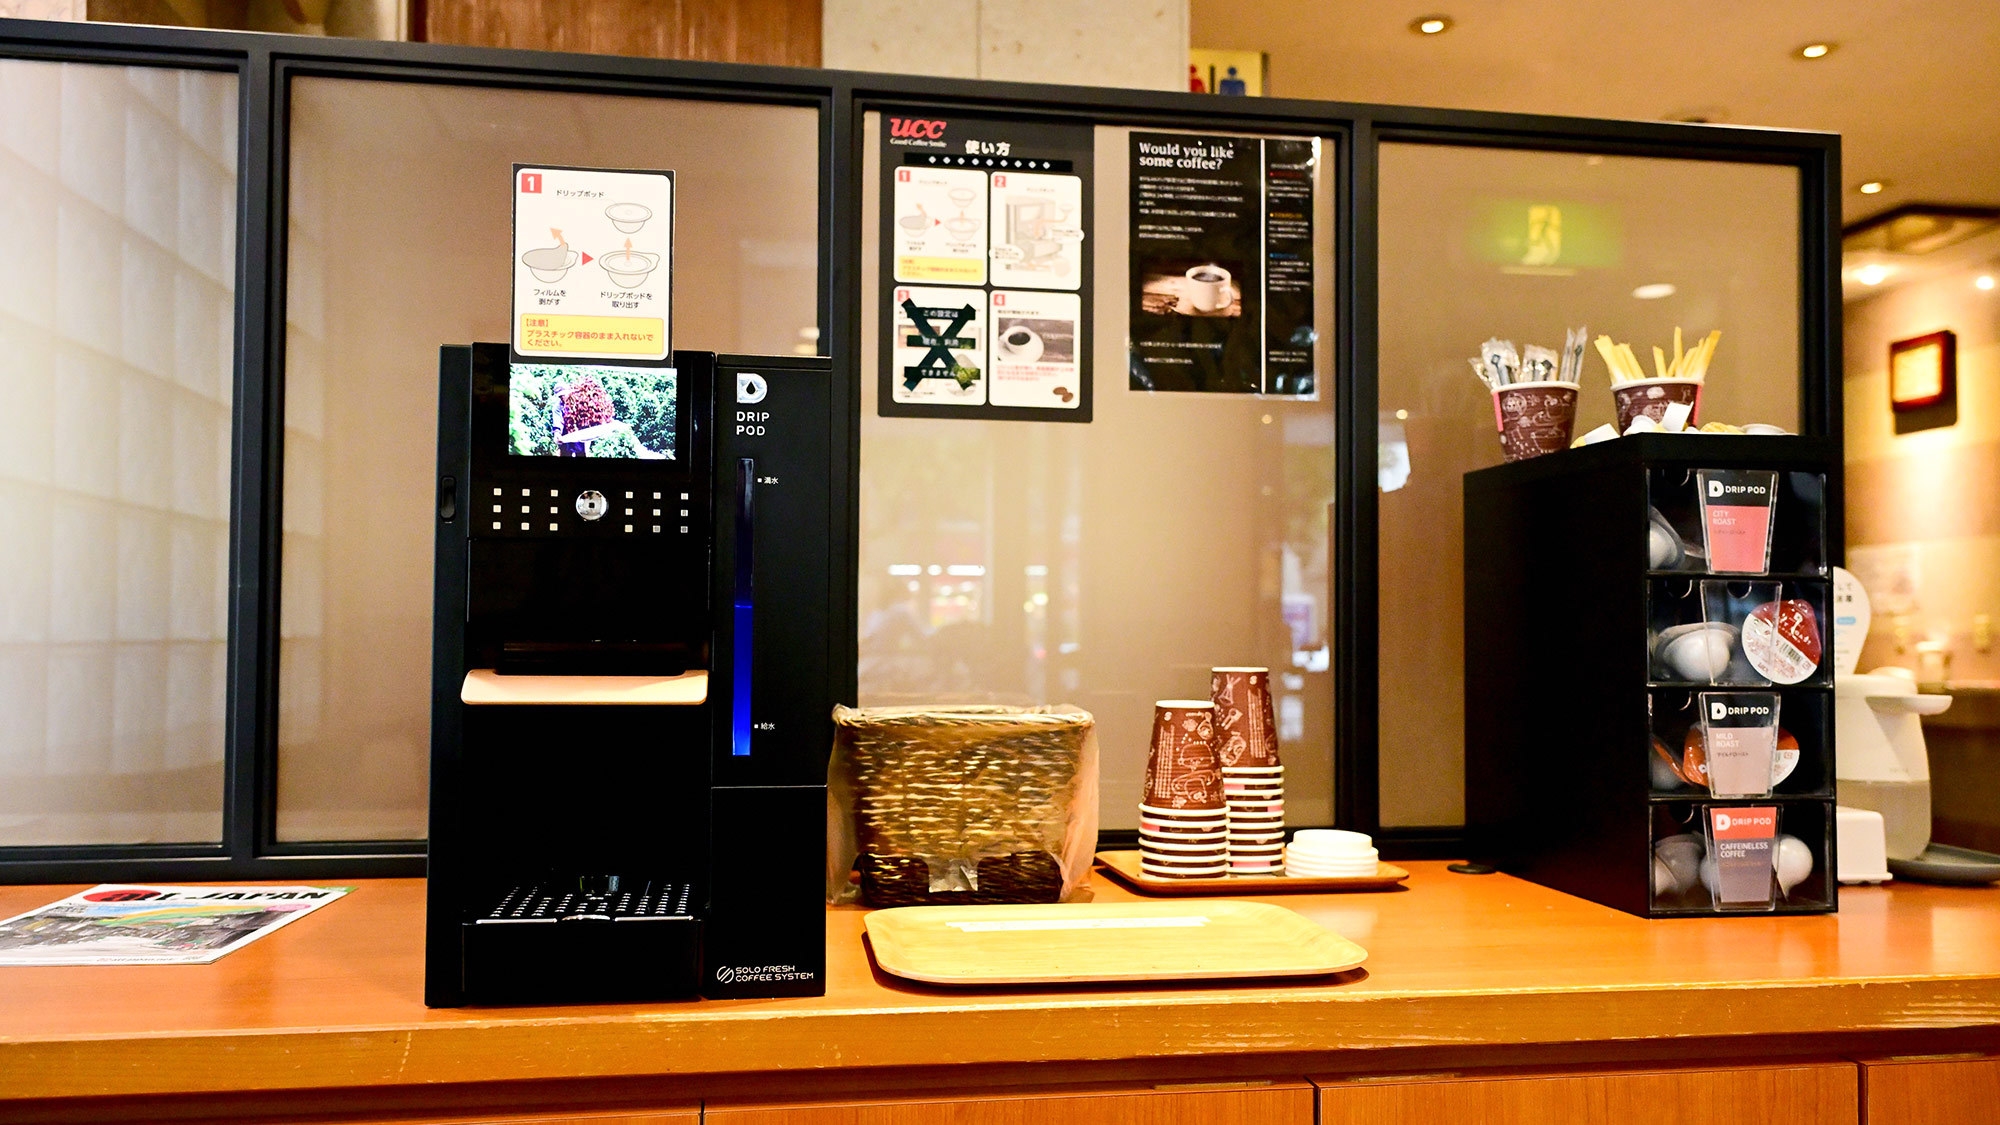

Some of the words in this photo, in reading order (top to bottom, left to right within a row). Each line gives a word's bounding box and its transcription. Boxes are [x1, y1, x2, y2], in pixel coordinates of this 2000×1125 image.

[965, 140, 1011, 156] 使い方
[1139, 142, 1180, 156] Would
[1183, 146, 1207, 158] you
[1210, 145, 1235, 159] like
[1139, 156, 1174, 168] some
[1176, 157, 1223, 170] coffee?
[527, 176, 535, 191] 1
[556, 189, 605, 198] ドリップポッド
[534, 288, 567, 297] フィルムを
[600, 291, 653, 301] ドリップポッドを
[612, 300, 639, 309] 取り出す
[527, 329, 654, 342] プラスチック容器のまま入れないで
[527, 339, 562, 348] ください。
[736, 411, 770, 422] DRIP
[736, 425, 766, 436] POD
[1725, 485, 1746, 494] DRIP
[1747, 486, 1766, 494] POD
[1712, 518, 1736, 526] ROAST
[1728, 706, 1749, 715] DRIP
[1750, 706, 1769, 715] POD
[760, 722, 775, 731] 給水
[1715, 732, 1733, 740] MILD
[1715, 740, 1740, 748] ROAST
[1732, 817, 1752, 826] DRIP
[1753, 817, 1772, 825] POD
[1720, 842, 1768, 851] CAFFEINELESS
[1720, 850, 1746, 858] COFFEE
[735, 966, 761, 974] SOLO
[762, 965, 795, 973] FRESH
[735, 974, 773, 982] COFFEE
[774, 972, 814, 981] SYSTEM
